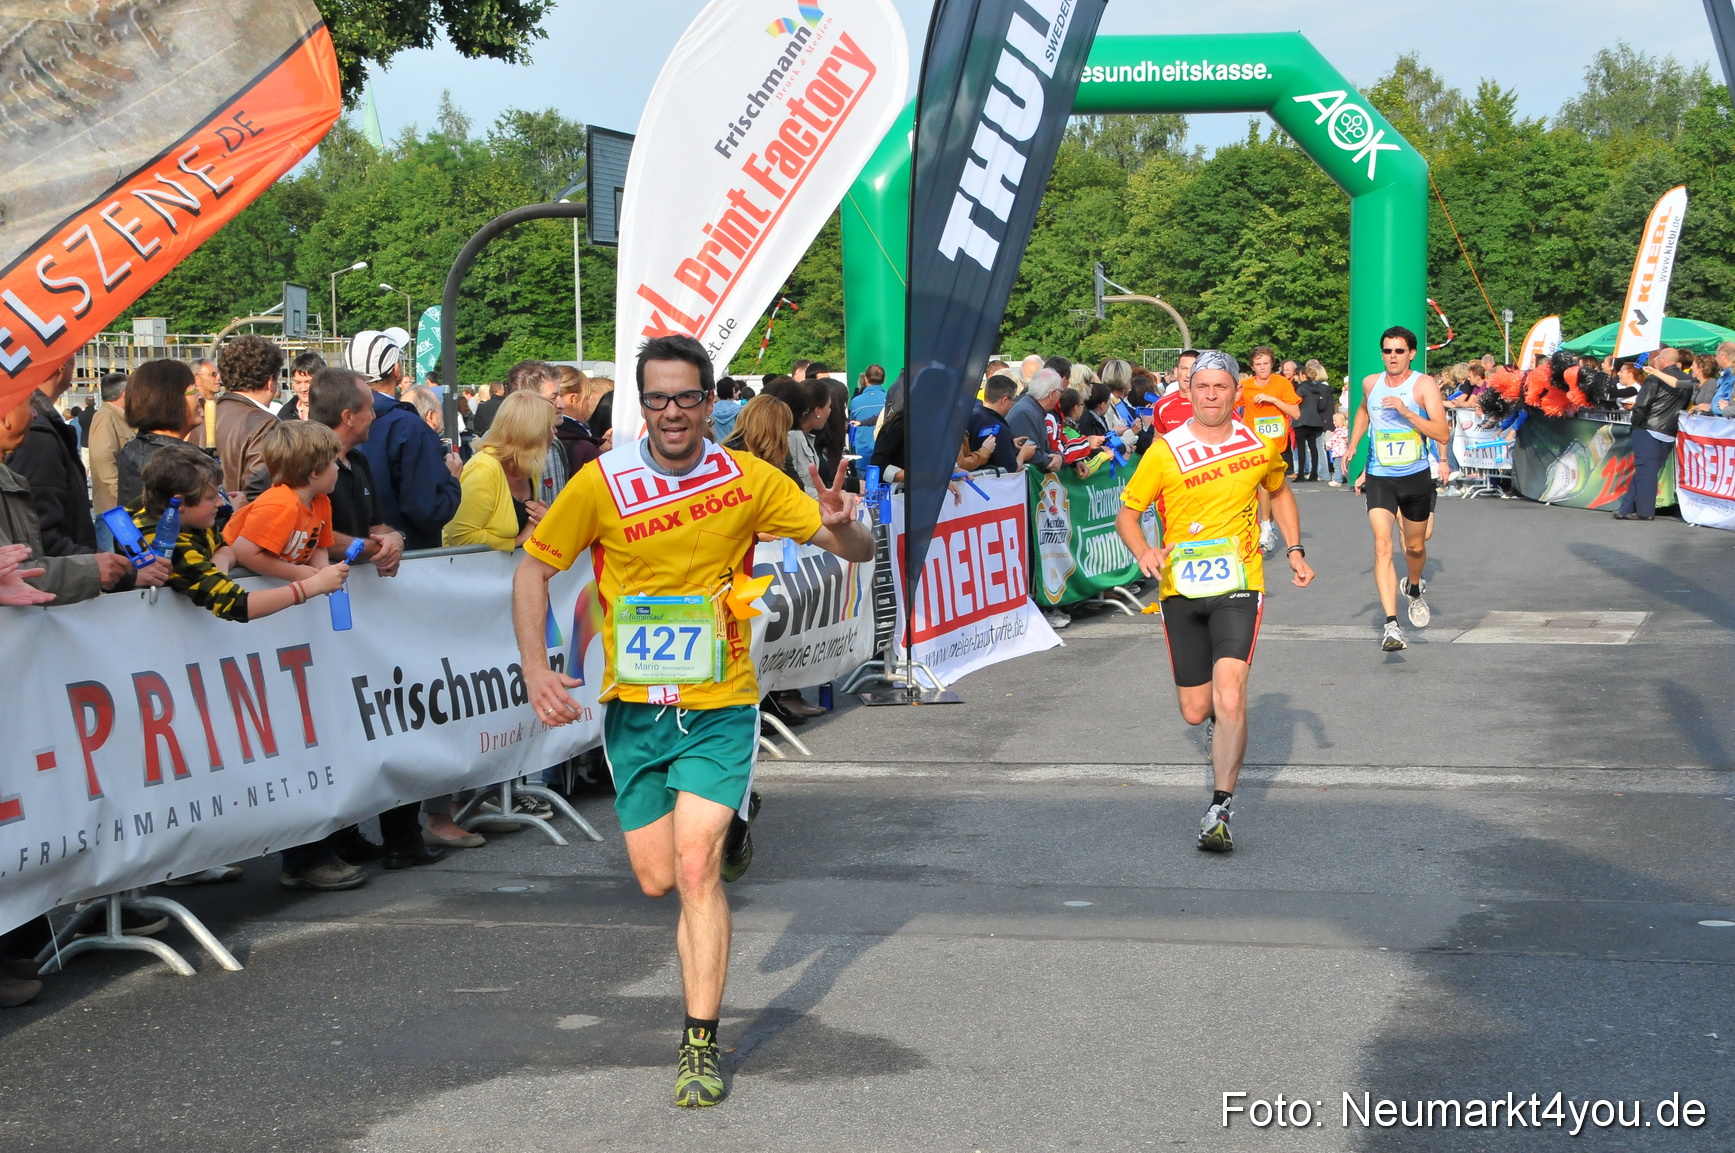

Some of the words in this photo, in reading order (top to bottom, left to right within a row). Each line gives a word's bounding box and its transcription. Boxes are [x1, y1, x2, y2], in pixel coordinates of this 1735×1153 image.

[776, 69, 800, 101] Druck
[805, 16, 833, 56] Medien
[1080, 60, 1273, 83] esundheitskasse.
[714, 26, 812, 160] Frischmann
[1292, 90, 1402, 182] AOK
[674, 188, 772, 305] Print
[741, 31, 877, 200] Factory
[1638, 206, 1673, 302] KLEBL
[1659, 216, 1681, 283] www.klebl.de
[707, 317, 738, 362] et.de
[1258, 423, 1279, 434] 603
[1386, 441, 1406, 456] 17
[1184, 467, 1225, 489] MAX
[1227, 454, 1269, 474] BÖGL
[1684, 439, 1735, 499] MEIE
[623, 509, 684, 543] MAX
[689, 487, 753, 521] BÖGL
[914, 517, 1026, 634] MEIER
[1181, 557, 1231, 583] 423
[625, 625, 702, 661] 427
[634, 662, 660, 671] Mario
[351, 652, 565, 742] Frischman
[0, 643, 319, 827] -PRINT
[479, 722, 523, 754] Druck
